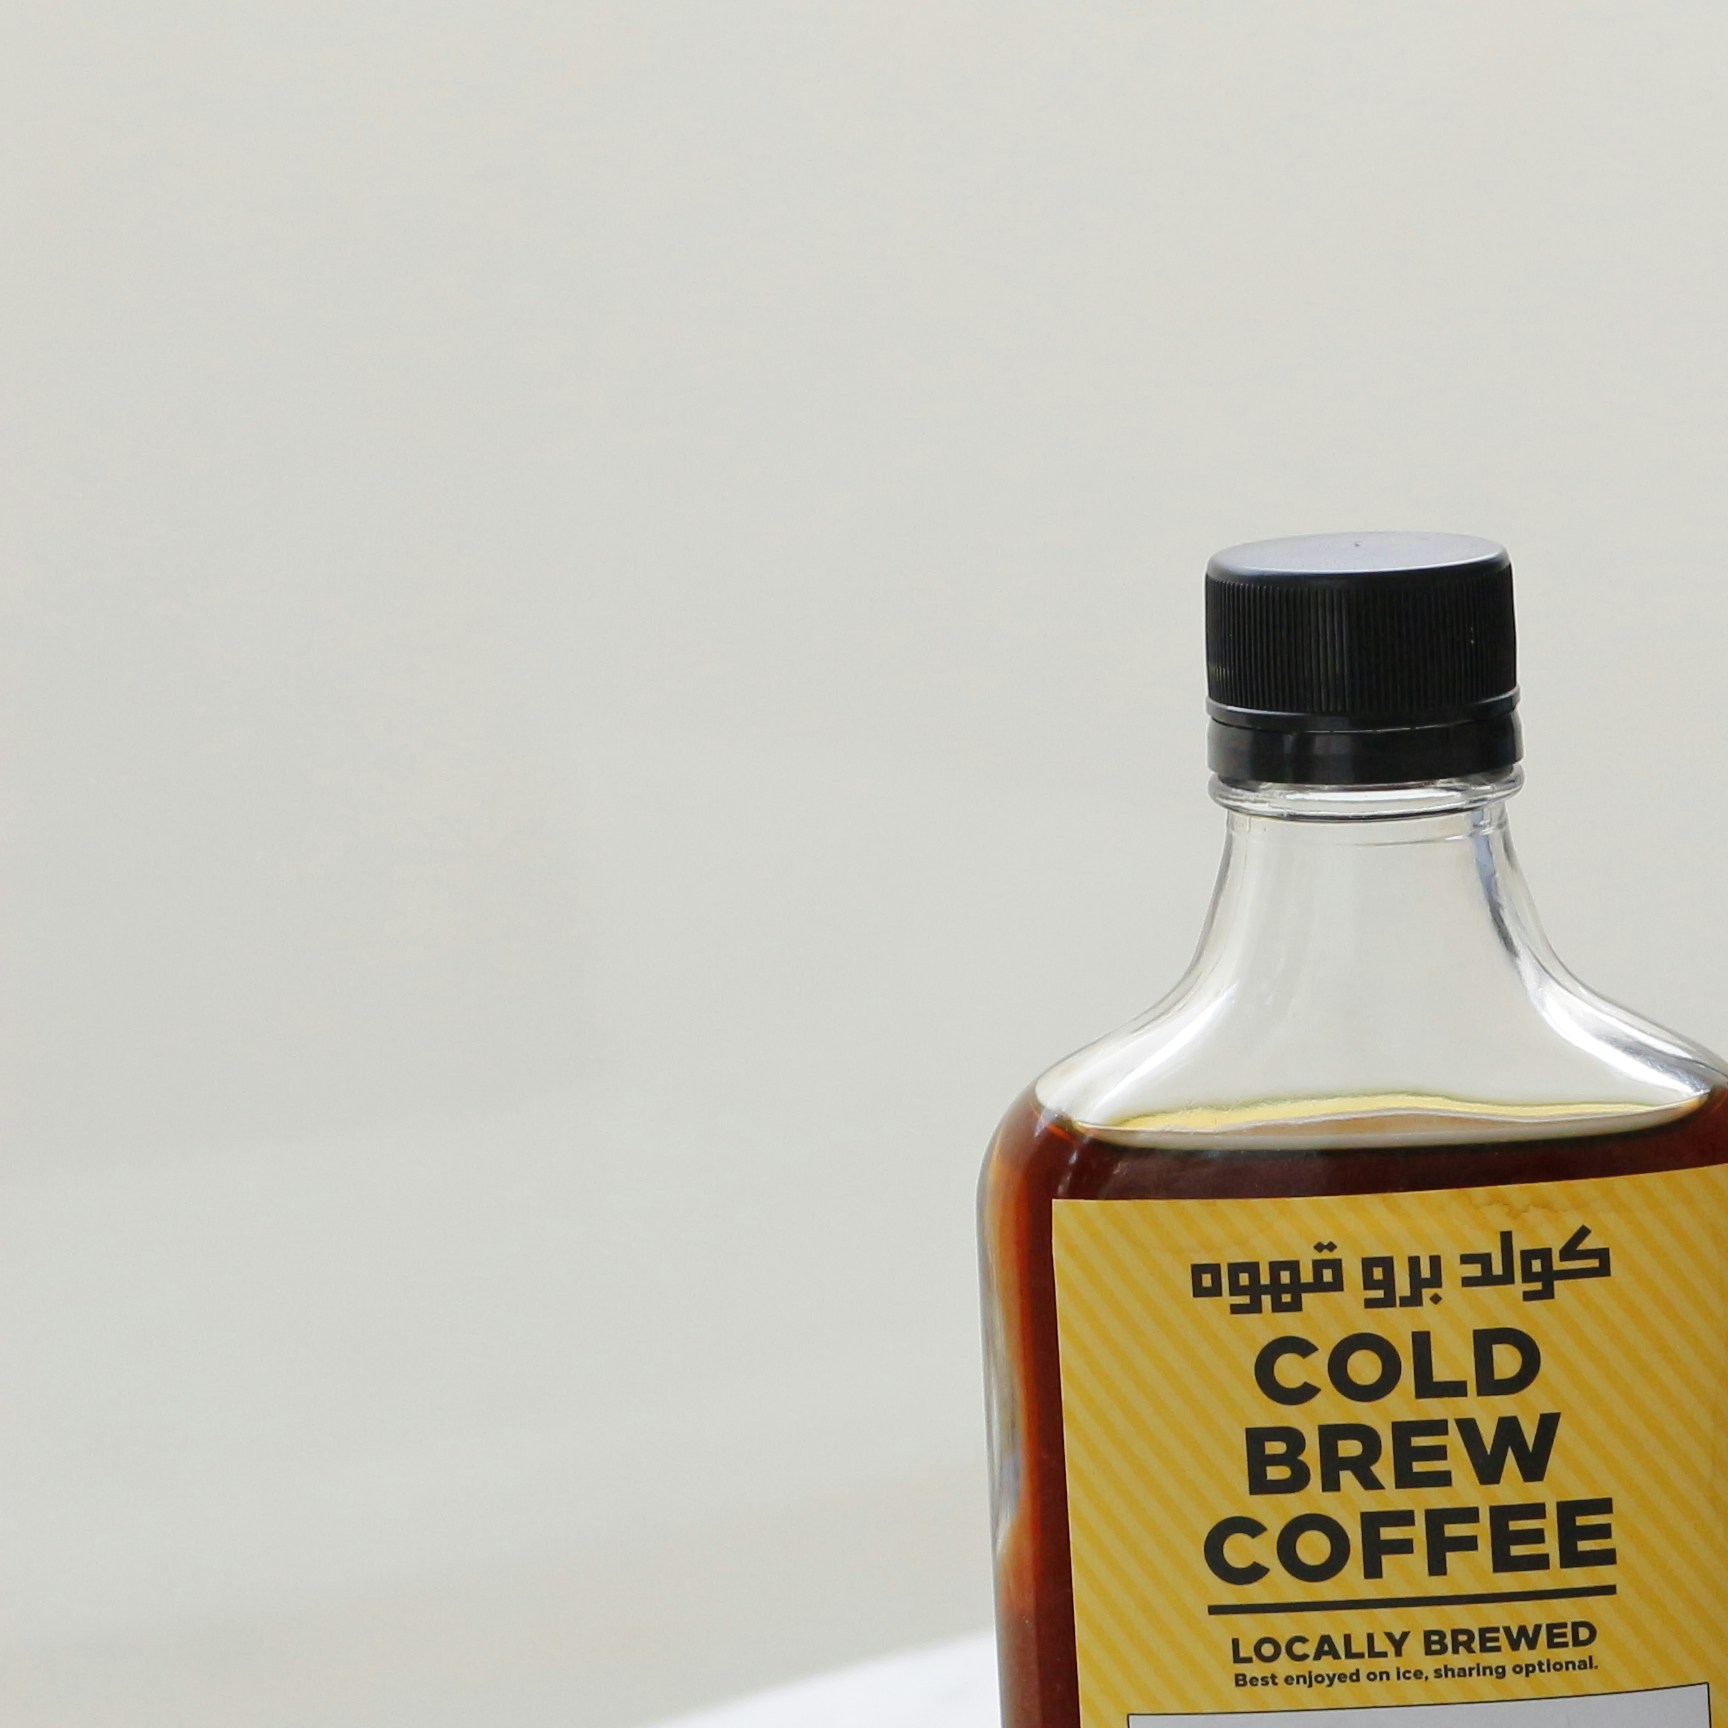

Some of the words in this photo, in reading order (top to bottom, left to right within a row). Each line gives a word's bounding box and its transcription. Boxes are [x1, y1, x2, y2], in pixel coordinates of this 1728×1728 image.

[1361, 1254, 1443, 1309] برو
[1459, 1224, 1612, 1302] كولد
[1253, 1326, 1542, 1406] COLD
[1244, 1412, 1562, 1496] BREW
[1203, 1496, 1618, 1587] COFFEE
[1231, 1630, 1411, 1665] LOCALLY
[1422, 1621, 1599, 1658] BREWED
[1234, 1672, 1278, 1688] Best
[1283, 1668, 1361, 1689] enjoyed
[1366, 1668, 1390, 1682] on
[1396, 1666, 1429, 1682] ice,
[1433, 1661, 1507, 1680] sharing
[1511, 1656, 1599, 1677] optional.
